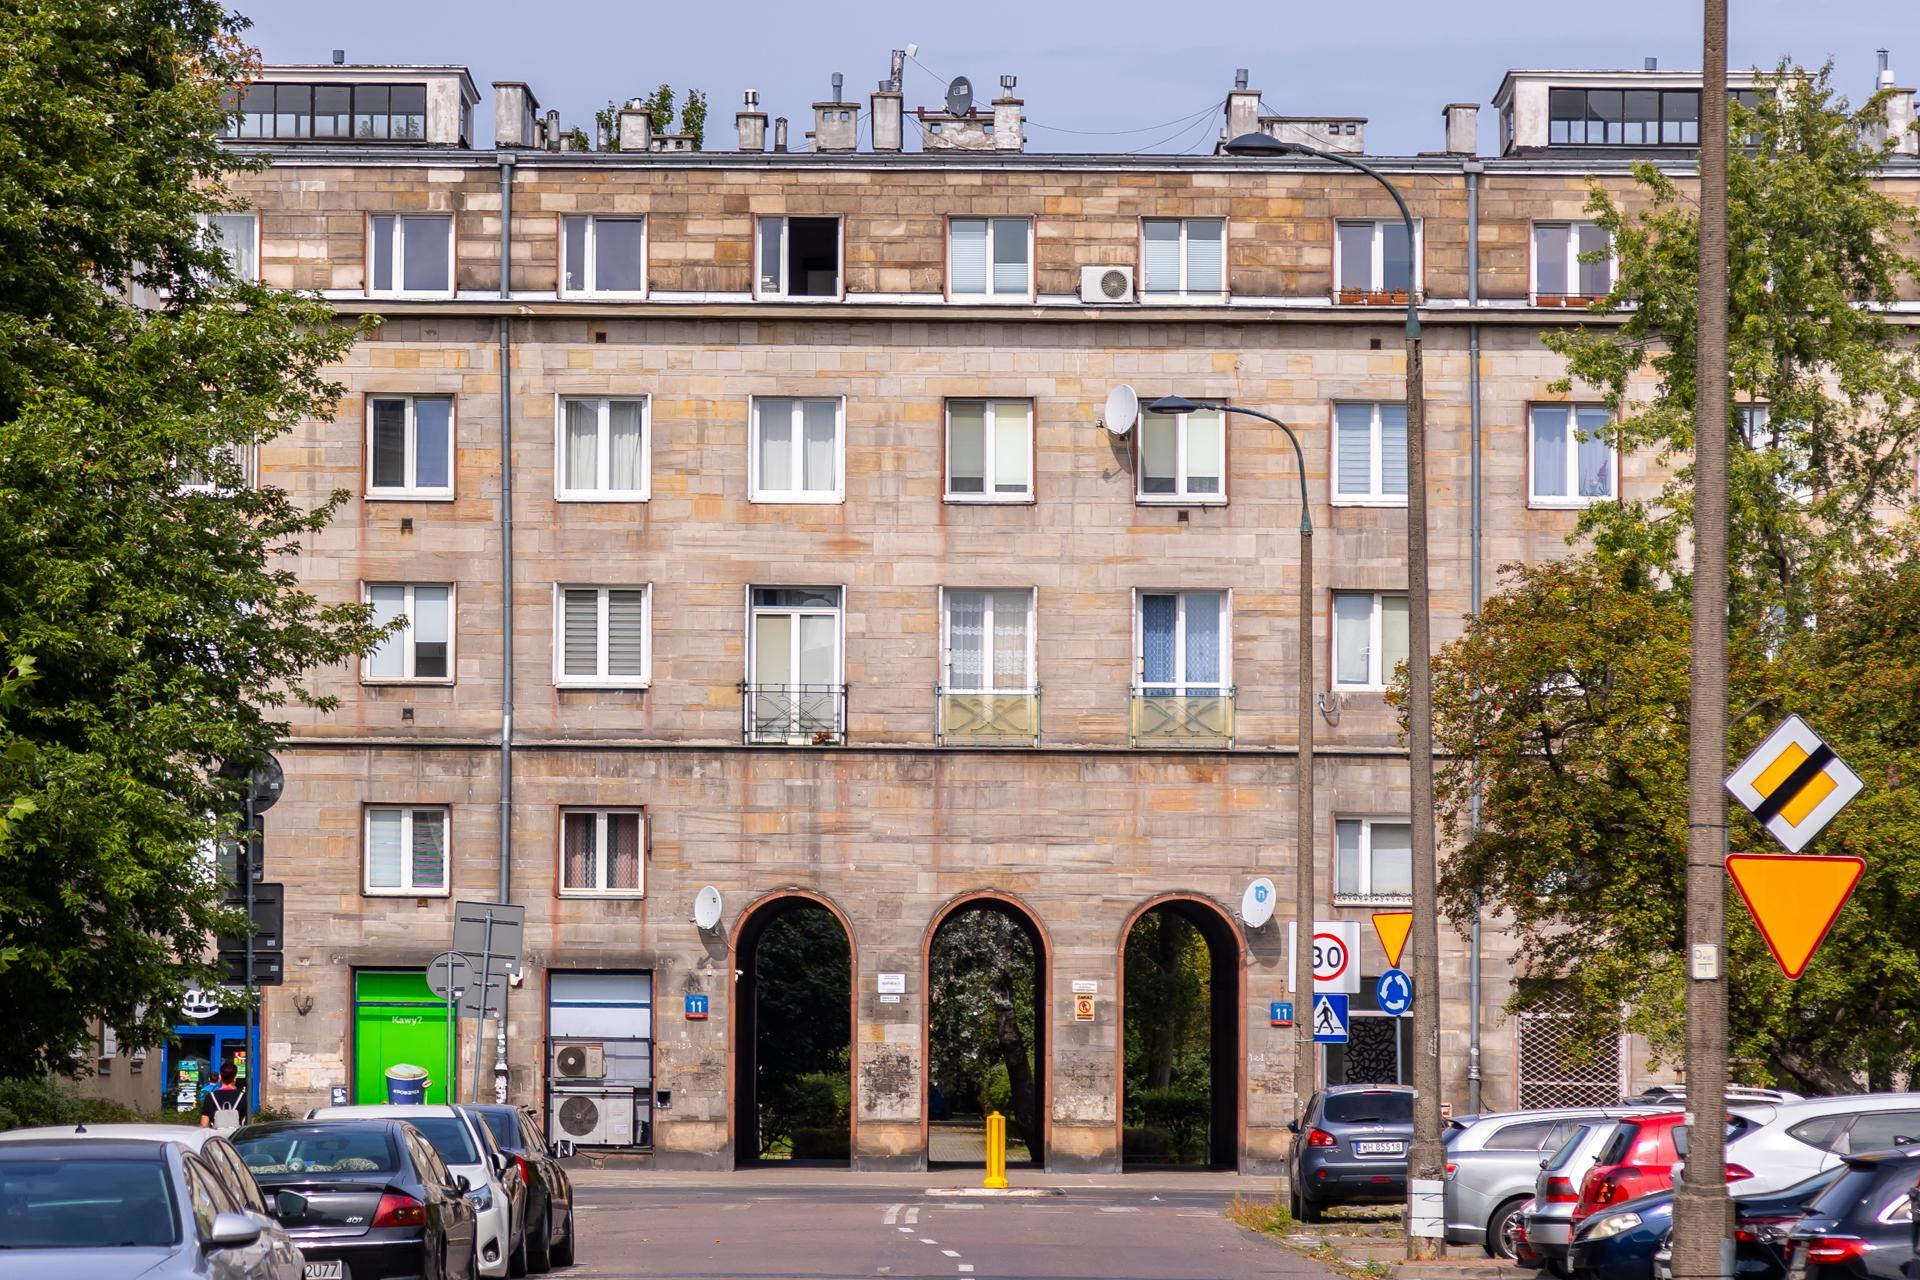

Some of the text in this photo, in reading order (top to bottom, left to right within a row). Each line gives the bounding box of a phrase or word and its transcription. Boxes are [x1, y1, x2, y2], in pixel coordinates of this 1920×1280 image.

[1313, 946, 1342, 968] 30
[690, 1000, 702, 1013] 11
[1275, 1008, 1288, 1020] 11
[391, 1015, 423, 1026] Kawy?
[346, 1216, 363, 1224] 407
[306, 1264, 338, 1278] 2U77
